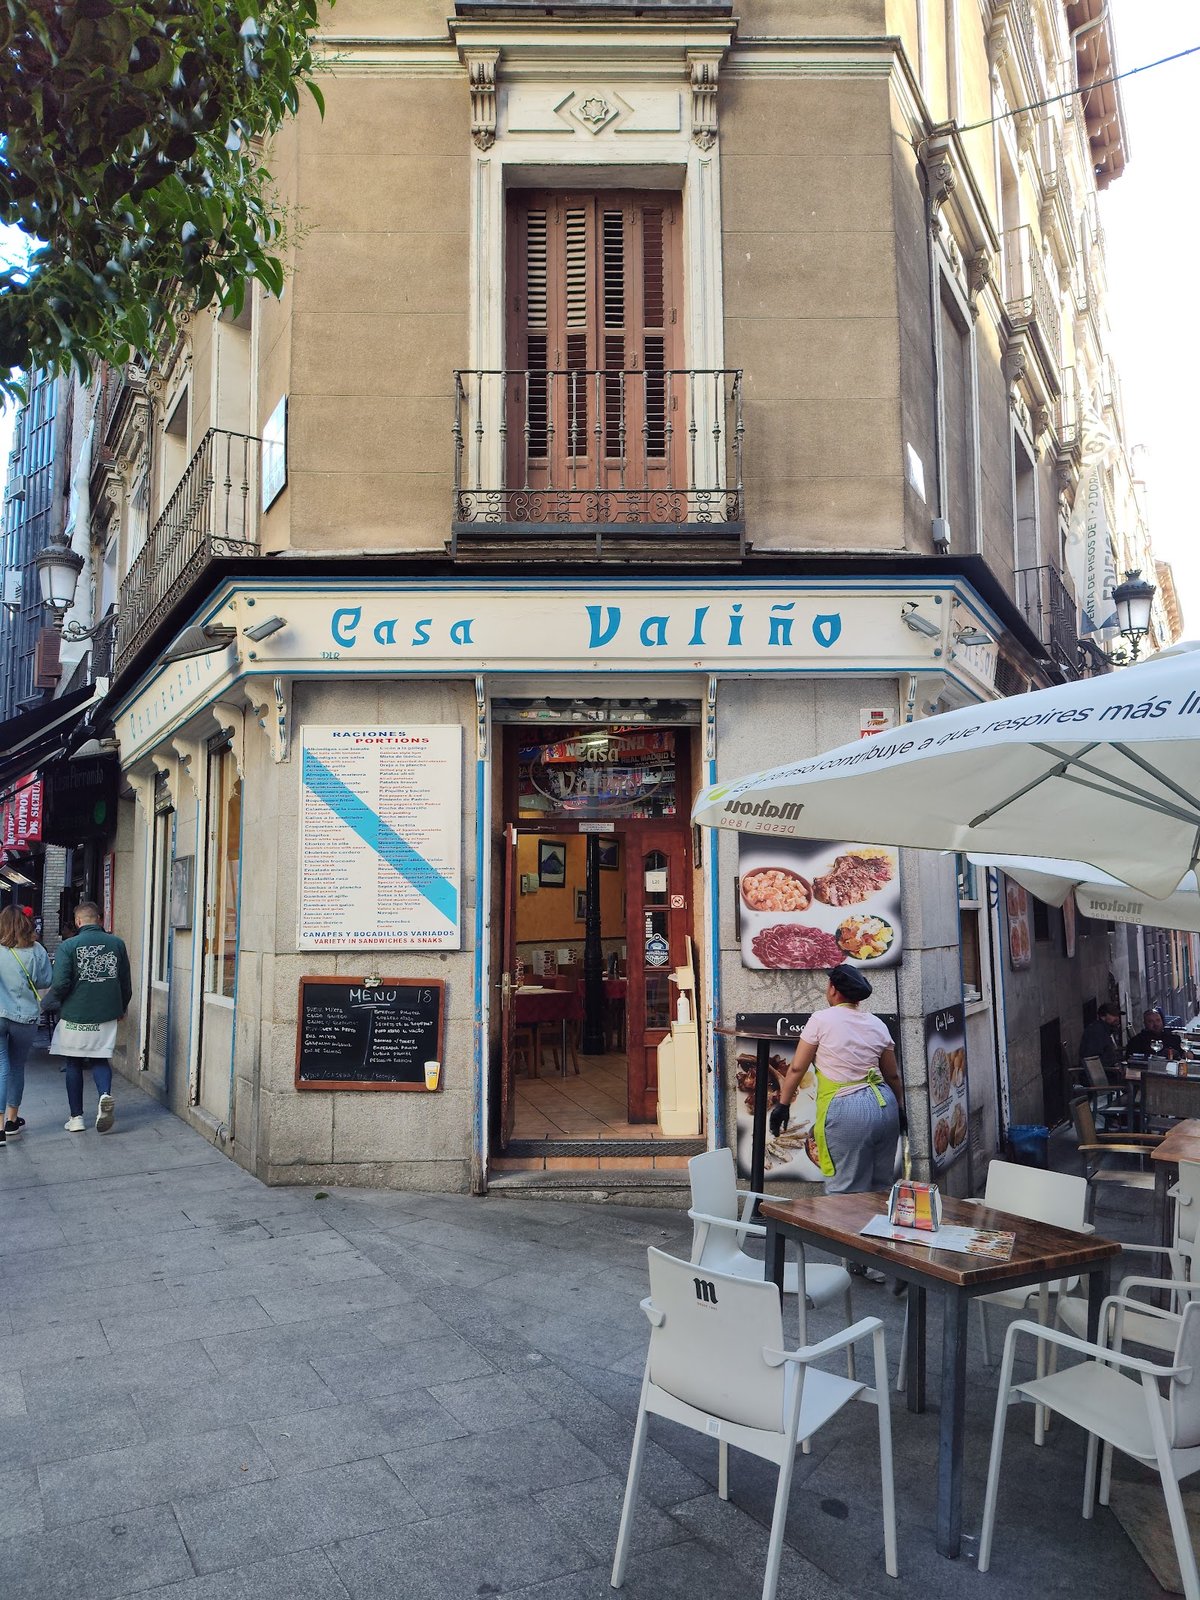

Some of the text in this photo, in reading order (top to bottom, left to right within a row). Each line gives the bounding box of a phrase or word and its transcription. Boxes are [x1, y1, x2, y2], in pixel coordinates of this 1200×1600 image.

[1088, 523, 1096, 538] DE
[1088, 540, 1096, 570] PISOS
[1087, 575, 1096, 590] DE
[331, 602, 842, 649] Casa Valiño
[820, 737, 915, 771] contribuye
[918, 738, 935, 750] a
[936, 725, 980, 746] que
[982, 706, 1095, 731] respires
[1098, 696, 1172, 722] más
[575, 742, 619, 762] Casa
[18, 793, 28, 834] HOTPOT
[30, 820, 38, 834] DE
[349, 988, 397, 1003] MENU
[78, 1023, 100, 1032] SCHOOL
